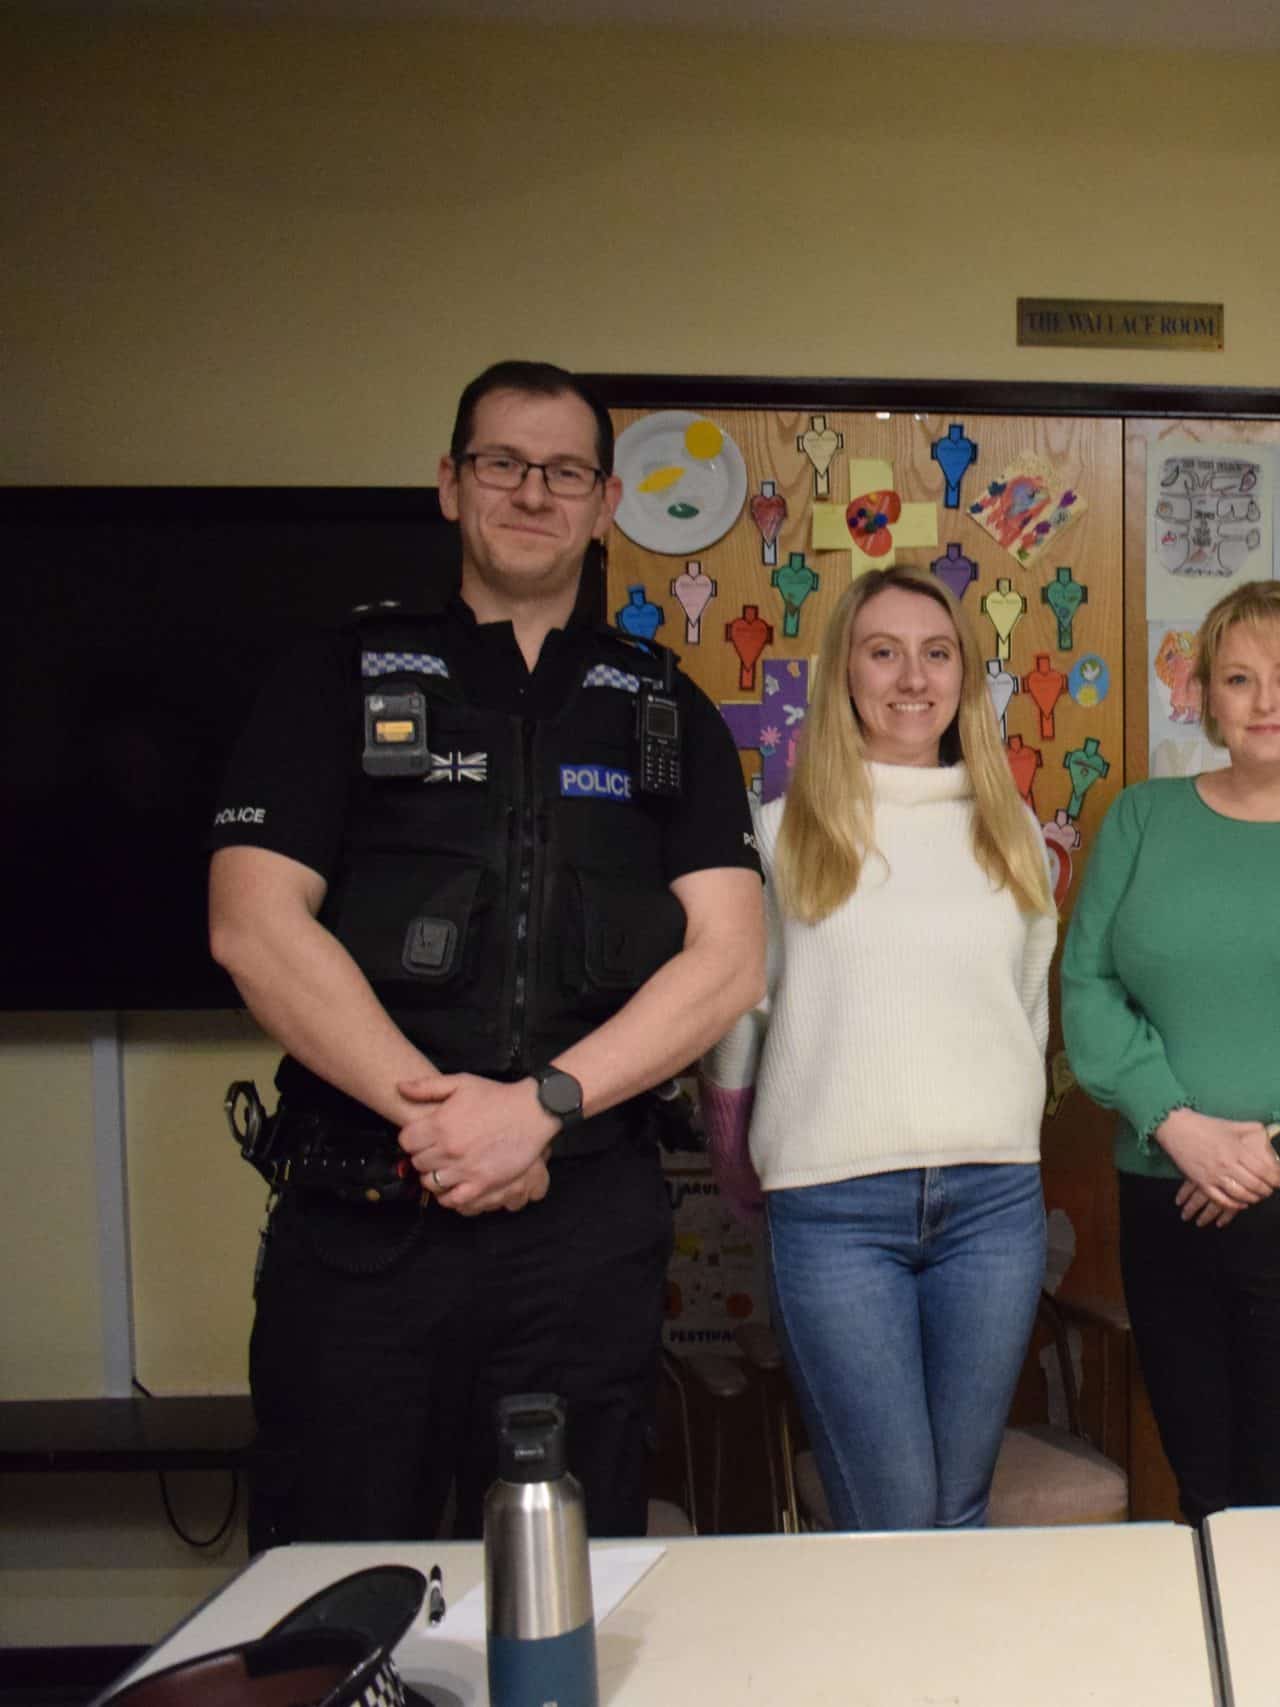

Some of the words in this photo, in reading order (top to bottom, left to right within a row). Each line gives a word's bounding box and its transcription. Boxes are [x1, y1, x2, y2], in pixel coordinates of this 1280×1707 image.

[1024, 311, 1059, 332] THE
[1068, 312, 1154, 335] WALLACE
[1160, 314, 1215, 337] ROOM
[561, 768, 632, 798] POLICE
